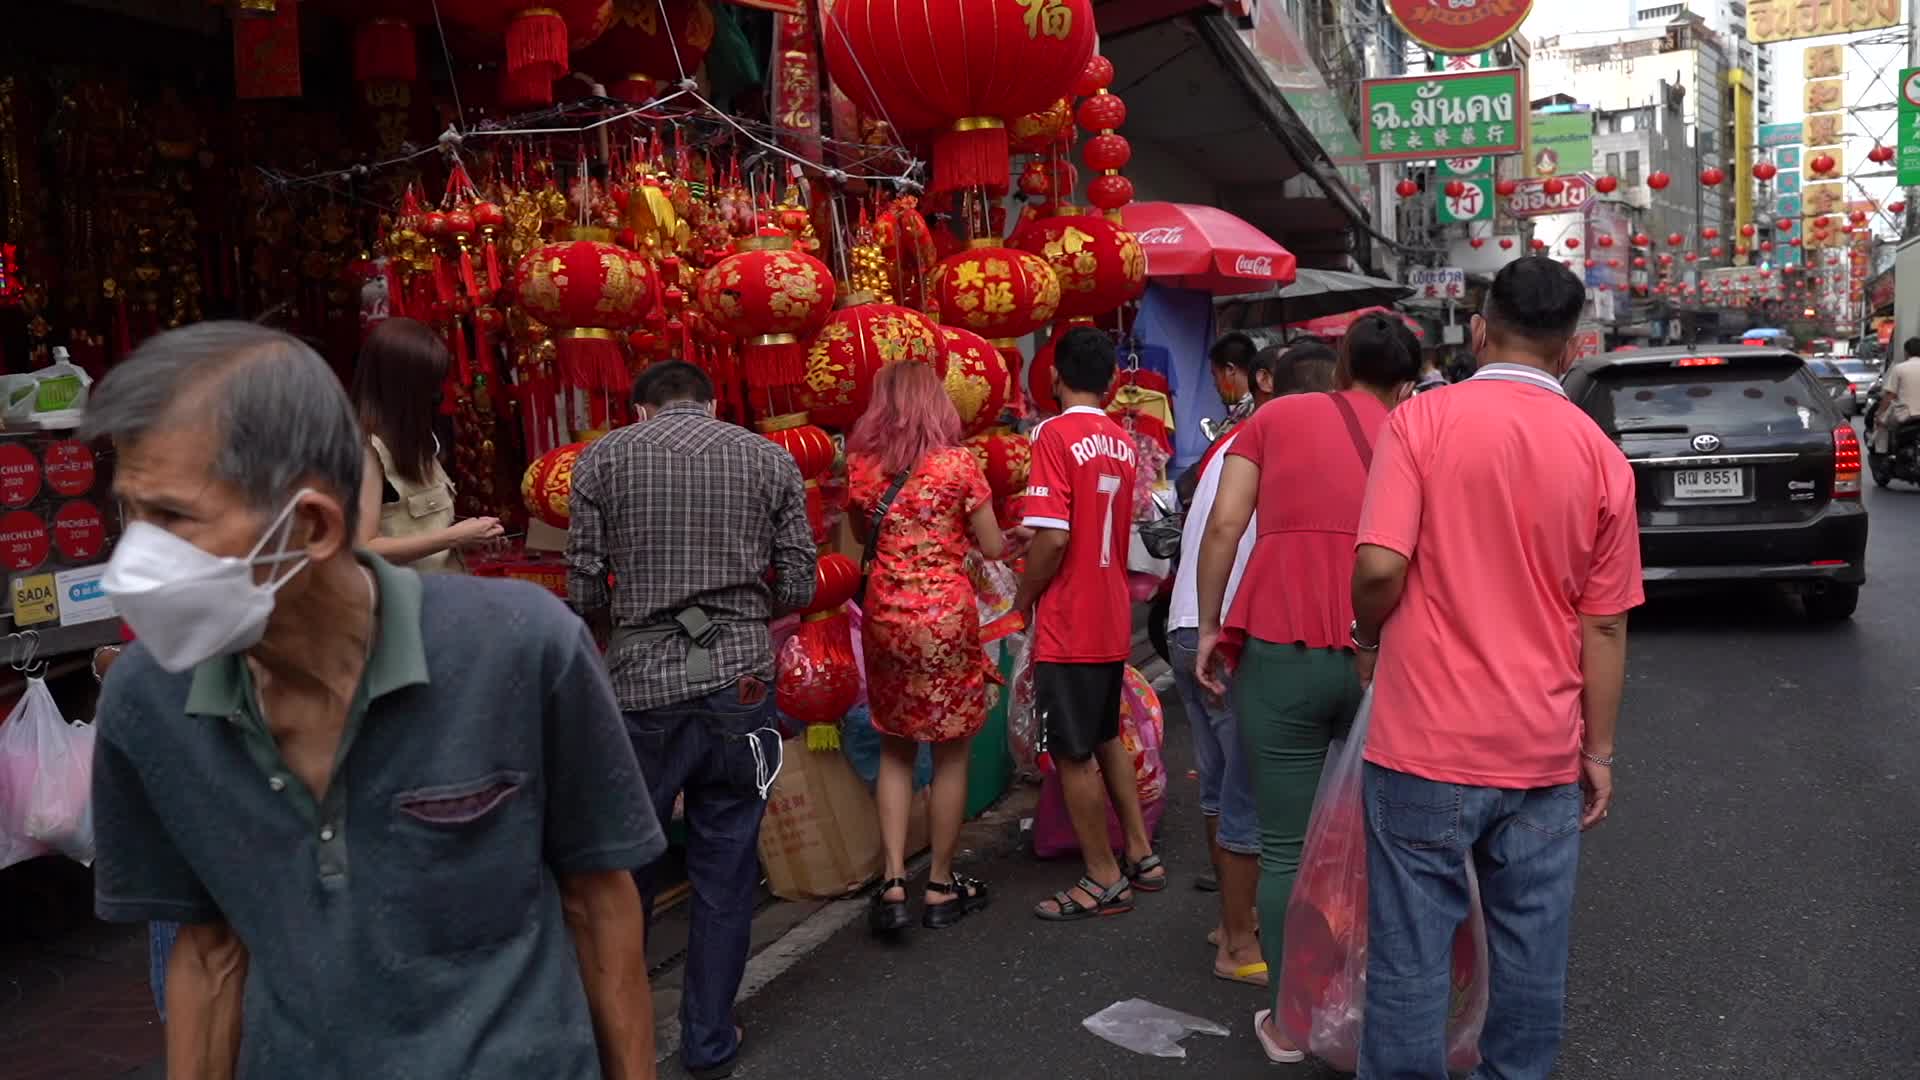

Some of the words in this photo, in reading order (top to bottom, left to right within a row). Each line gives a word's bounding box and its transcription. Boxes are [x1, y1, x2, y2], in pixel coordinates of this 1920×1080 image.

[1070, 434, 1136, 468] RONALDO
[1704, 470, 1738, 486] 8551
[57, 518, 99, 529] MICHELIN
[1097, 473, 1121, 567] 7
[17, 586, 52, 603] SADA
